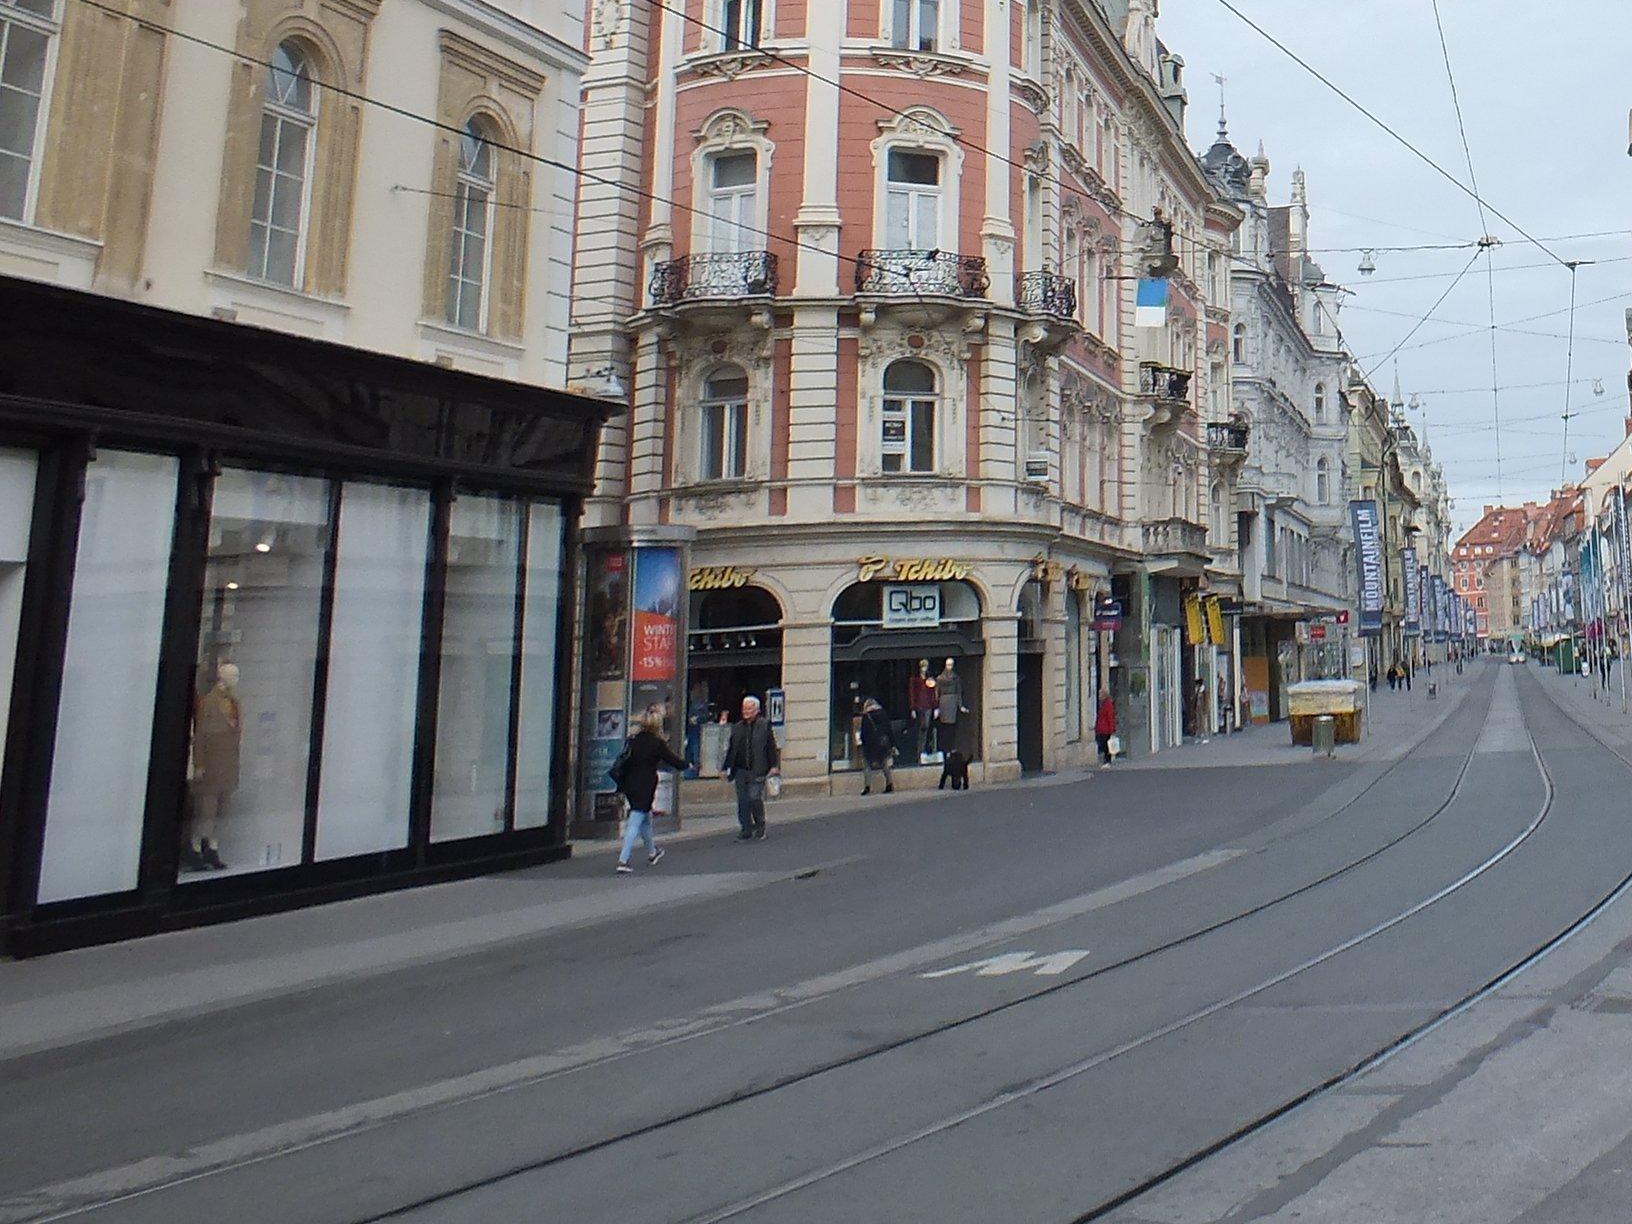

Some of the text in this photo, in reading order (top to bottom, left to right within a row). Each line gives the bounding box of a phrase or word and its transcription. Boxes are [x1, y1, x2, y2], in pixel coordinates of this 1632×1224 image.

[893, 558, 975, 582] Tchibo
[1356, 508, 1381, 612] MOUNTAINFILM
[690, 565, 757, 590] chibo
[889, 590, 936, 614] Qbo
